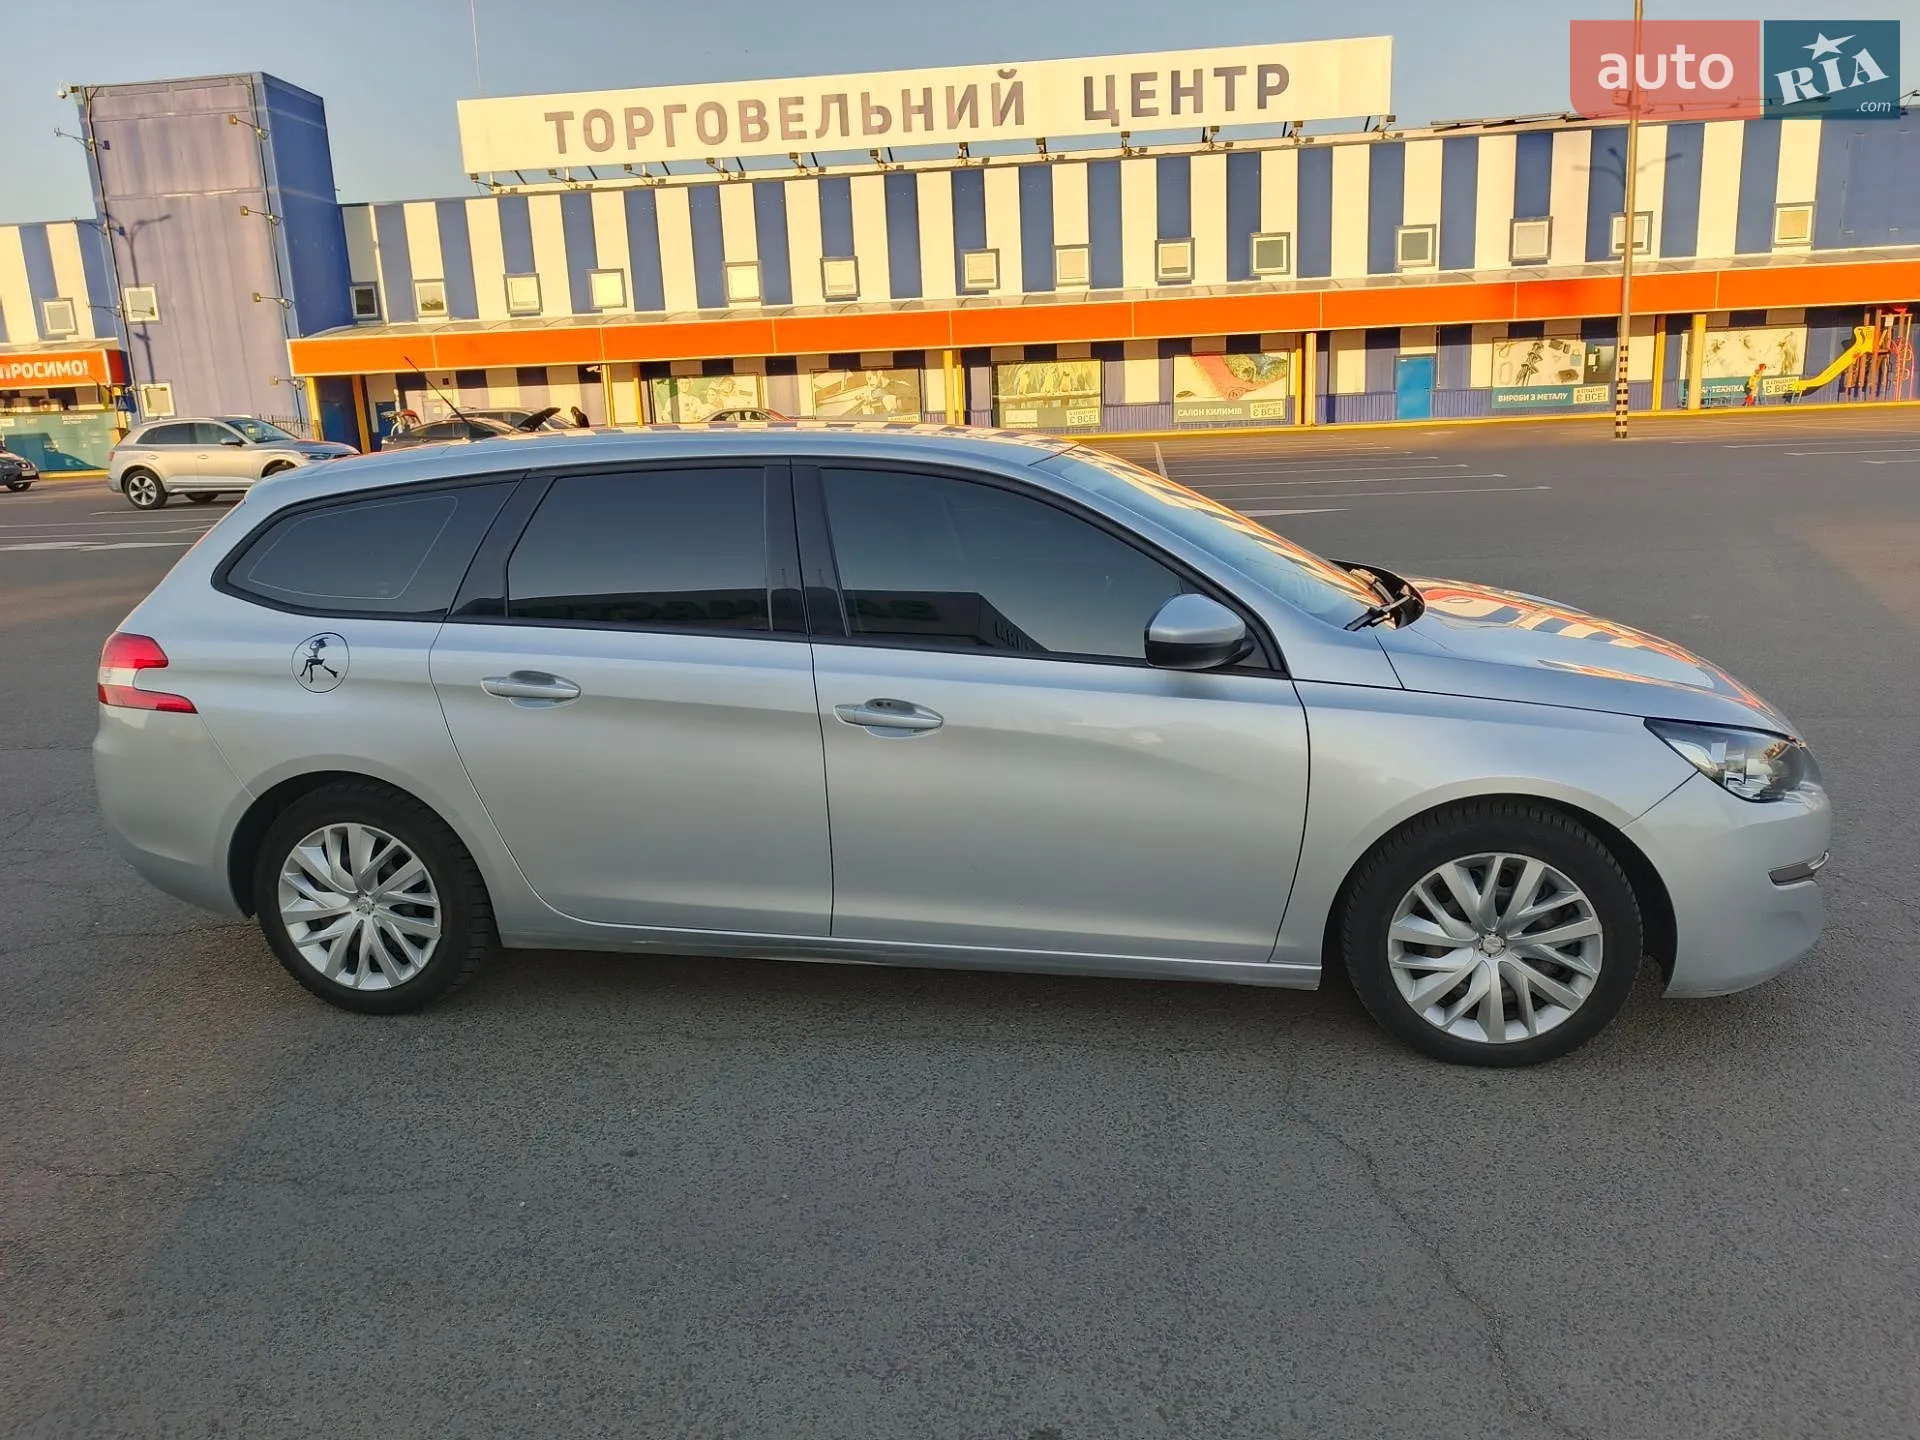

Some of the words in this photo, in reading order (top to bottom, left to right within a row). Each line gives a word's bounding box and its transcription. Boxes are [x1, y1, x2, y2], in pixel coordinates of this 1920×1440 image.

[544, 68, 1025, 155] ТОРГОВЕЛЬНИЙ
[1083, 63, 1290, 127] ЦЕНТР
[1537, 392, 1568, 401] МЕТАЛУ
[1177, 409, 1205, 417] САЛОН
